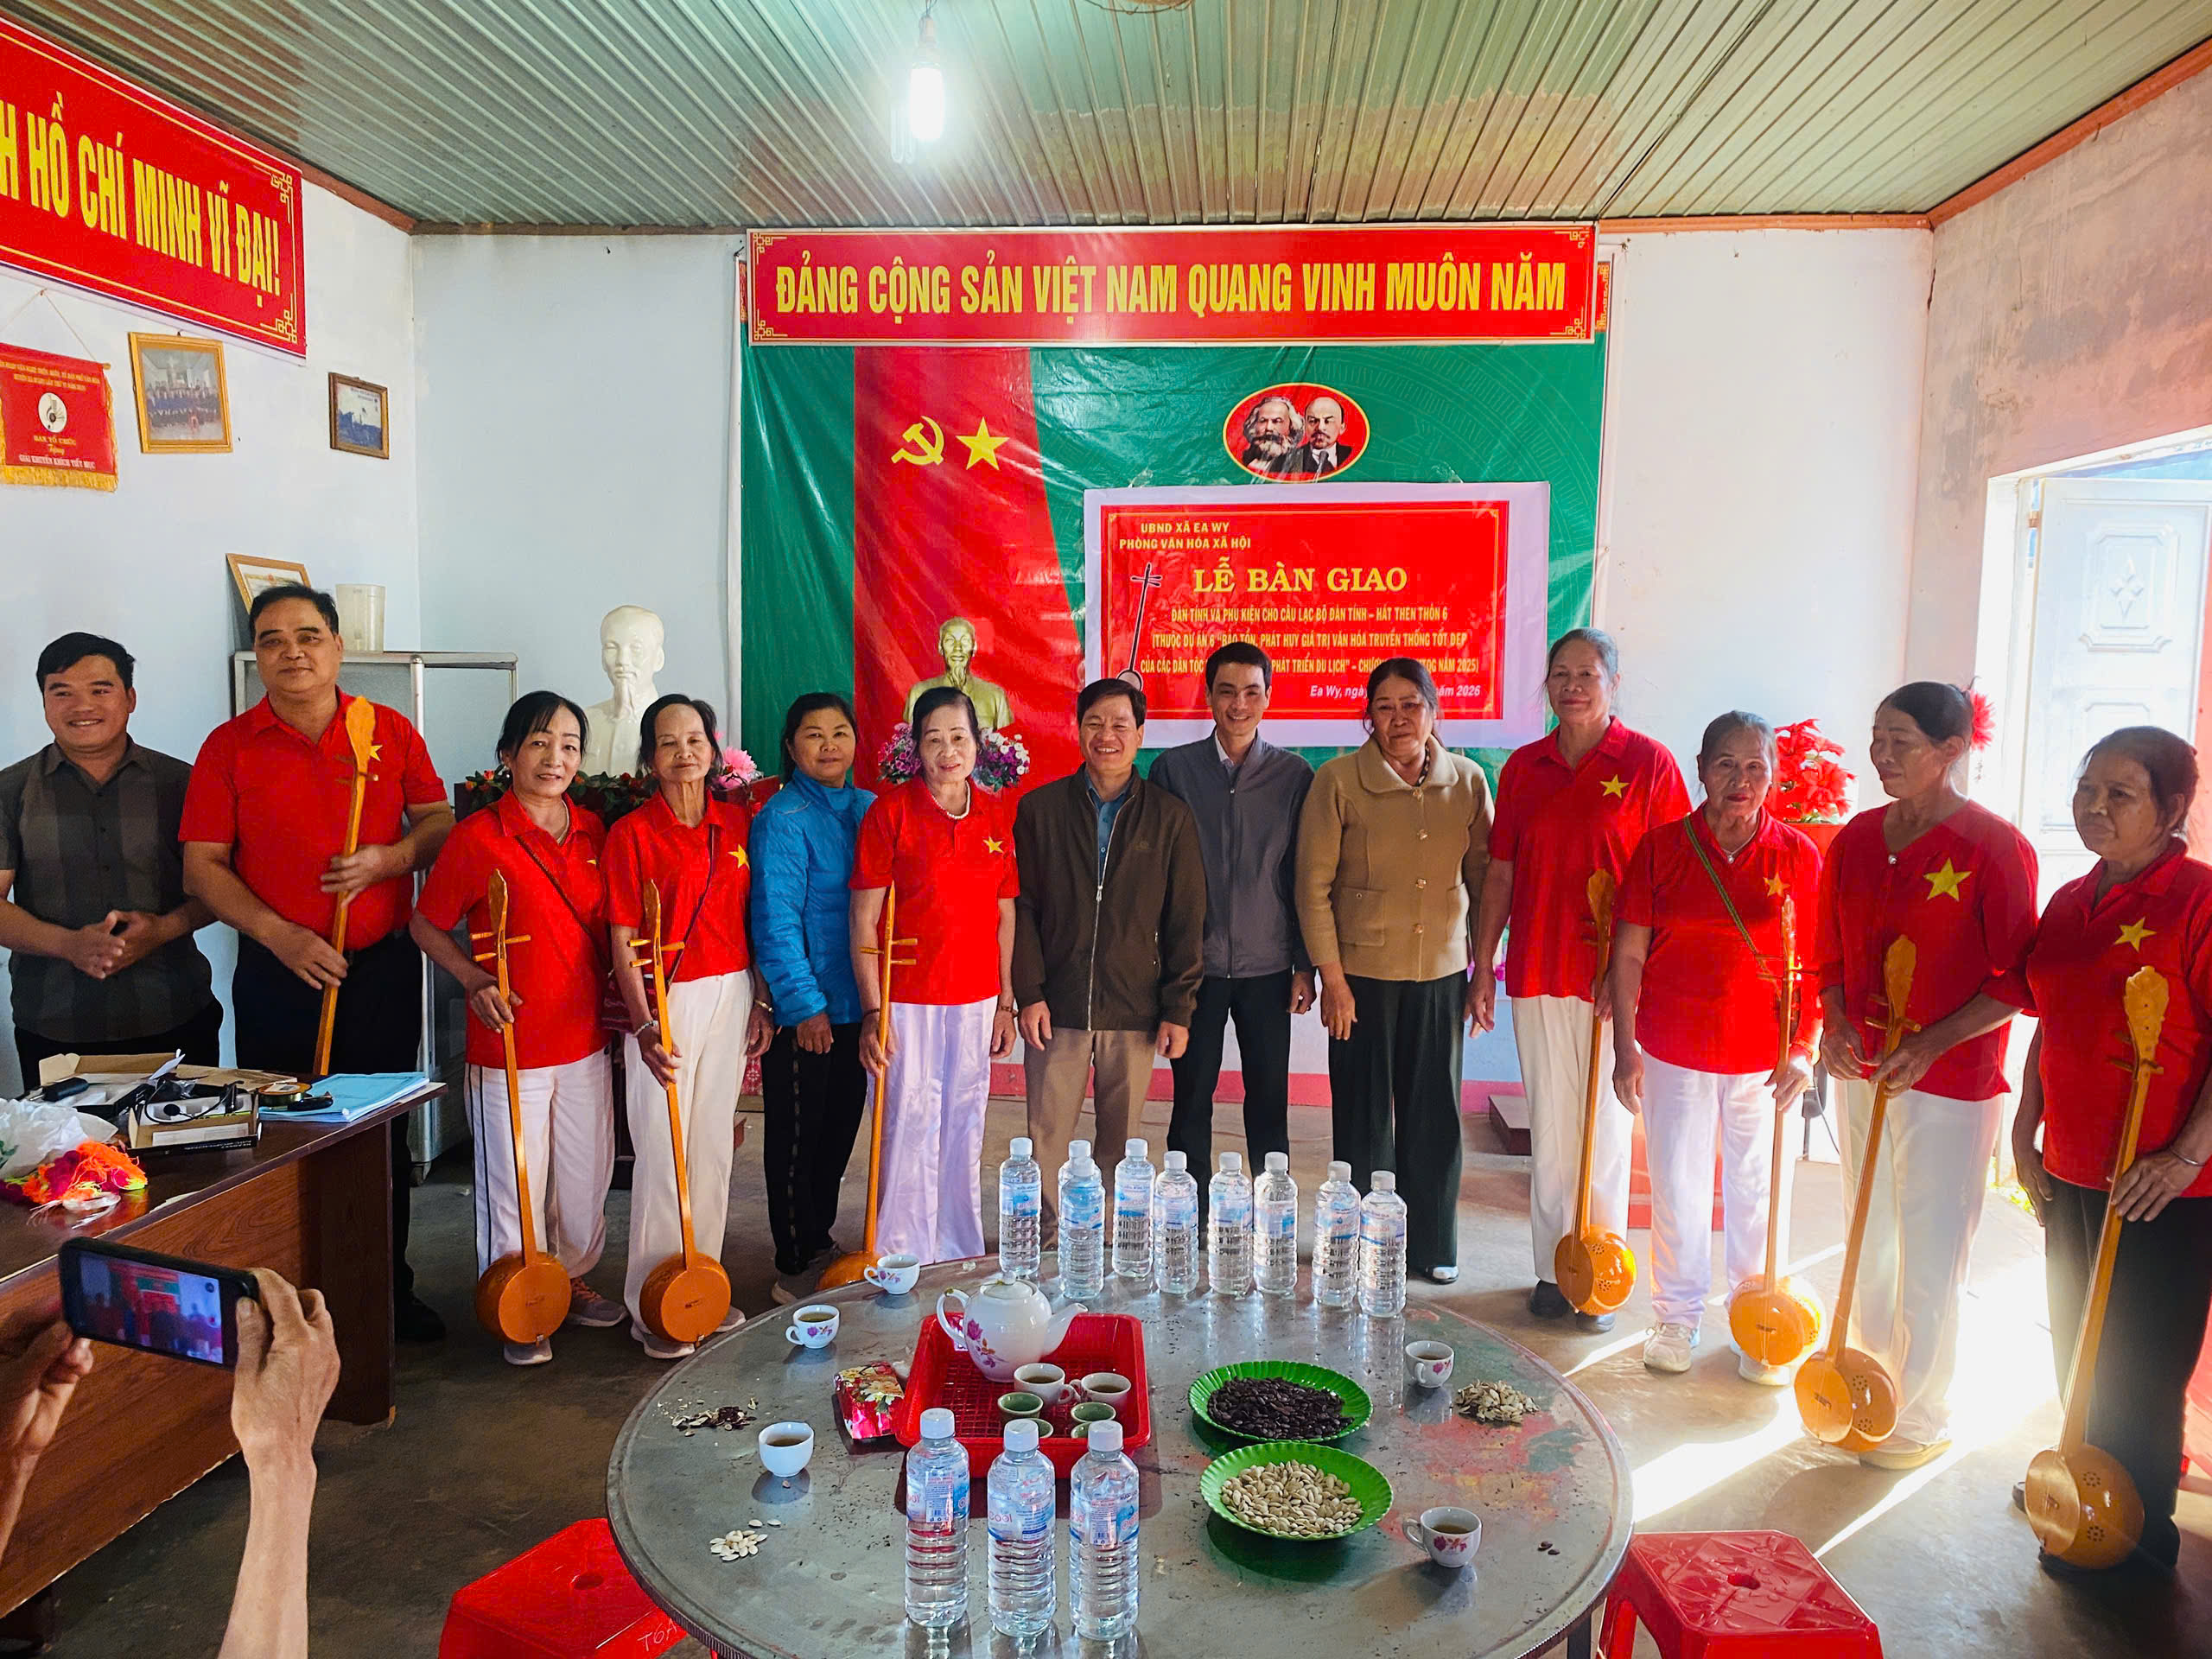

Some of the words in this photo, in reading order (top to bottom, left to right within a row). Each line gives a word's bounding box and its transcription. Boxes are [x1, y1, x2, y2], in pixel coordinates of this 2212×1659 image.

[27, 91, 69, 218] HỒ
[78, 132, 127, 240] CHÍ
[133, 158, 202, 268] MINH
[207, 180, 231, 277] VĨ
[235, 203, 280, 308] ĐẠI!
[776, 251, 858, 313] ĐẢNG
[868, 257, 950, 324] CỘNG
[961, 250, 1022, 313] SẢN
[1033, 255, 1096, 324] VIỆT
[1107, 265, 1177, 313] NAM
[1188, 264, 1292, 318] QUANG
[1302, 264, 1376, 311] VINH
[1386, 251, 1480, 311] MUÔN
[1491, 251, 1566, 311] NĂM
[1141, 523, 1173, 533] UBND
[1175, 520, 1191, 533] XÃ
[1193, 522, 1209, 532] EA
[1211, 522, 1230, 532] WY
[1119, 537, 1158, 550] PHÒNG
[1186, 536, 1210, 549] HÓA
[1212, 536, 1228, 548] XÃ
[1230, 535, 1251, 550] HỘI
[1193, 556, 1236, 593] LỄ
[1247, 561, 1315, 593] BÀN
[1326, 566, 1408, 592] GIAO
[1262, 607, 1279, 621] CHO
[1298, 607, 1314, 624] LẠC
[1348, 604, 1367, 621] TÍNH
[1376, 604, 1392, 621] HÁT
[1394, 607, 1416, 621] THEN
[1418, 603, 1440, 621] THÔN
[1442, 607, 1448, 621] 6
[1210, 634, 1215, 648] 6
[1260, 631, 1281, 647] PHÁT
[1283, 633, 1300, 647] HUY
[1301, 630, 1314, 647] GIÁ
[1316, 658, 1326, 672] DU
[1310, 685, 1323, 697] Ea
[1325, 685, 1343, 698] Wy,
[1456, 684, 1481, 696] 2026
